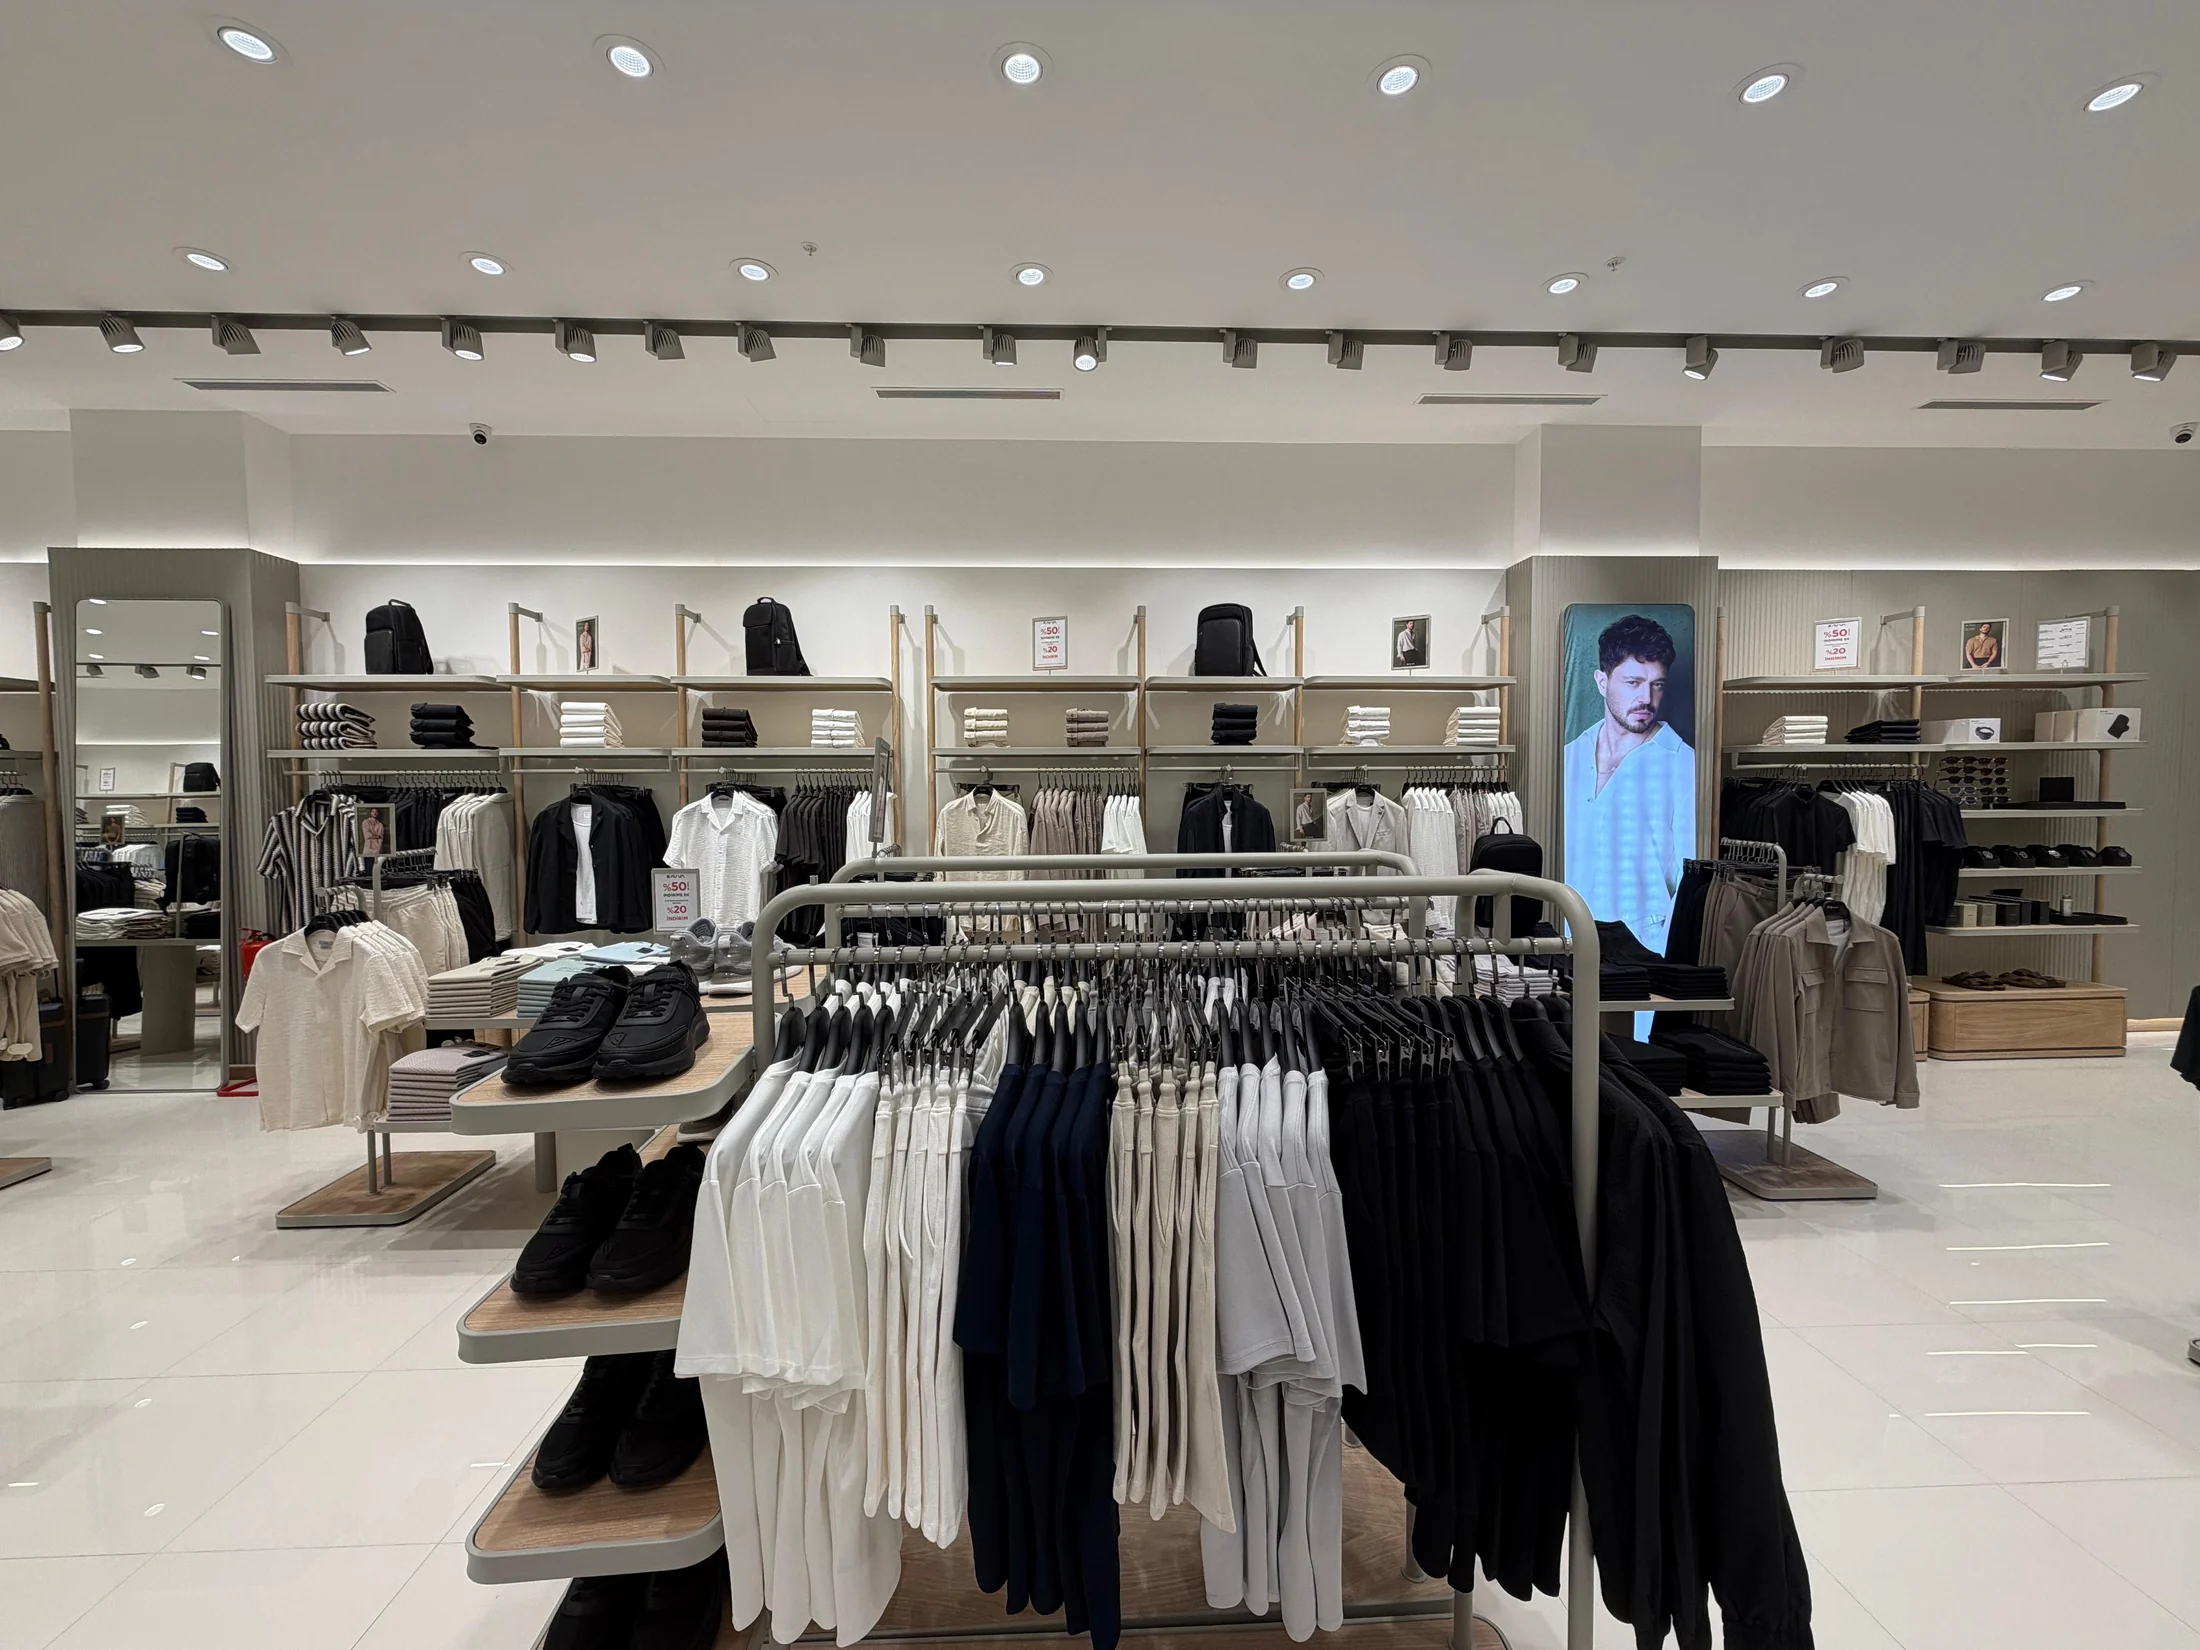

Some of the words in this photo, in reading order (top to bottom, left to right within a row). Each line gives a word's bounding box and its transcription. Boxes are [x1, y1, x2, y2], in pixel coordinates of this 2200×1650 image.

[1040, 626, 1058, 635] %50
[1824, 629, 1848, 638] %50
[663, 882, 686, 891] %50
[667, 906, 687, 914] %20
